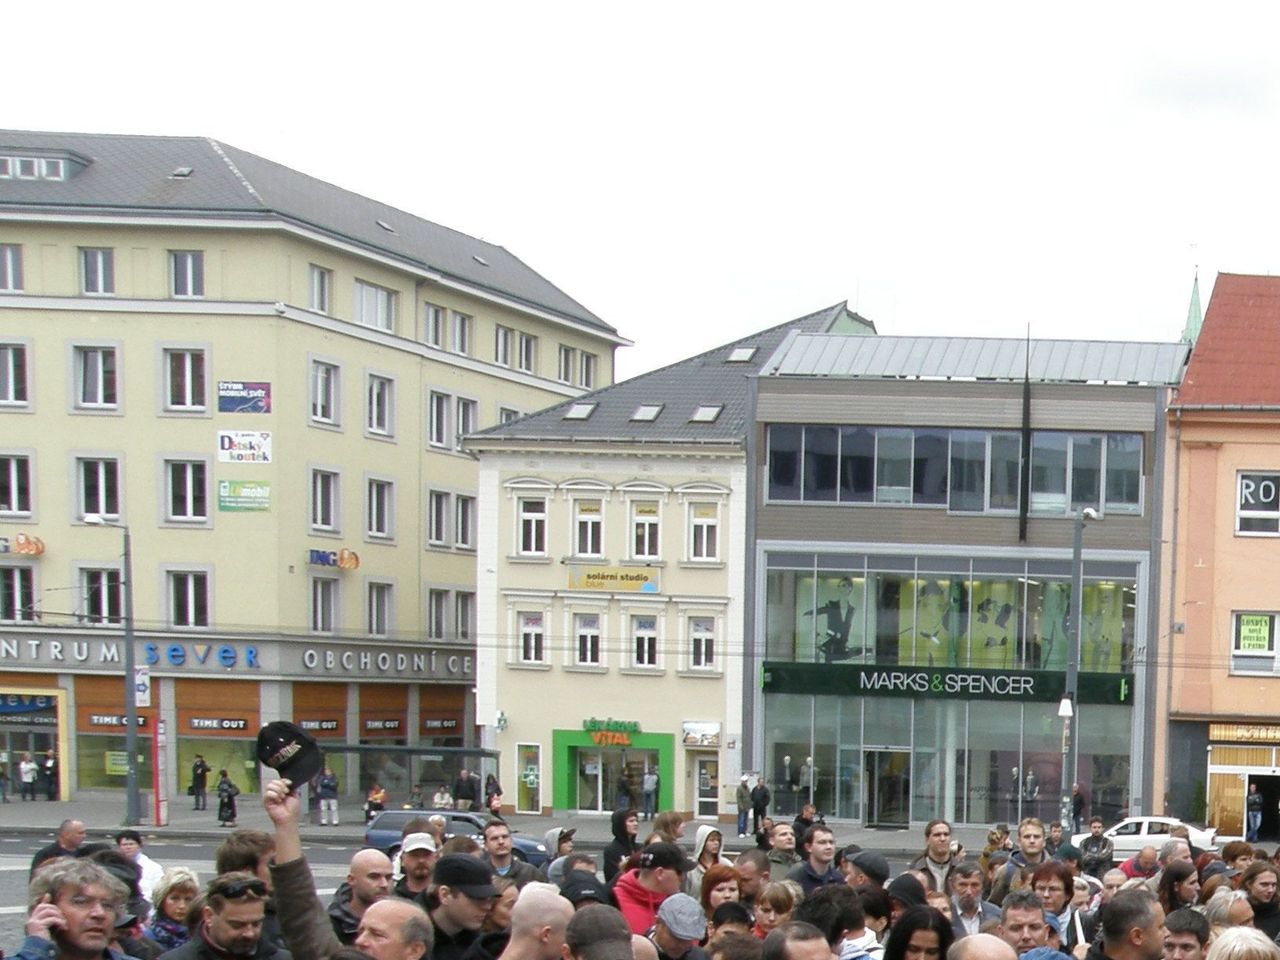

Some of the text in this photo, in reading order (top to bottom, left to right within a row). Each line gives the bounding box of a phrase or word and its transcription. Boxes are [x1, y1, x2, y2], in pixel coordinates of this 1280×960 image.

[309, 549, 337, 566] ING
[587, 572, 649, 582] solární studio
[304, 649, 472, 673] OBCHODNÍ CE
[92, 715, 118, 725] TIME
[192, 719, 246, 729] TIME OUT
[302, 721, 337, 729] TIME OUT
[366, 720, 399, 729] TIME OUT
[442, 720, 457, 728] OUT
